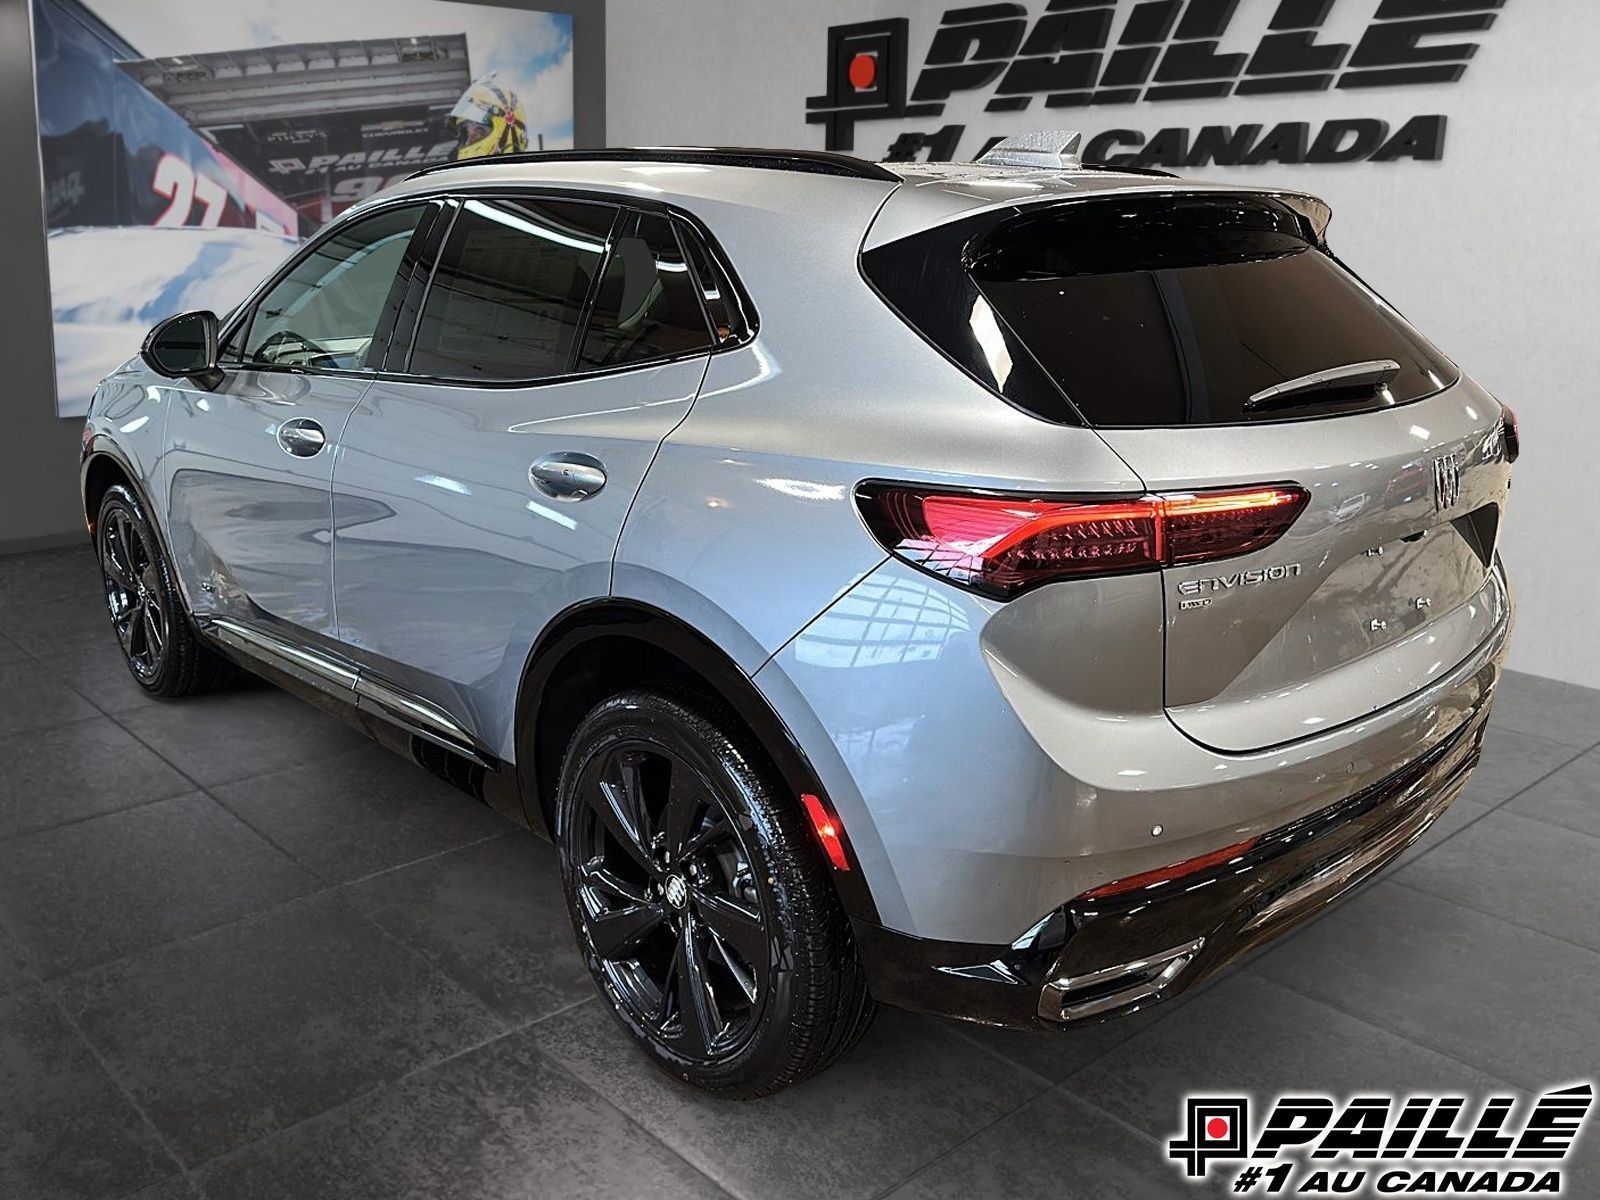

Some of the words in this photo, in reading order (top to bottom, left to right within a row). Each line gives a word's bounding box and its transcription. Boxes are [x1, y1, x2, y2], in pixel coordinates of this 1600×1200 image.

[882, 125, 966, 162] #1
[1081, 114, 1447, 166] CANADA
[152, 152, 228, 229] 27
[1178, 563, 1301, 595] ENVISION
